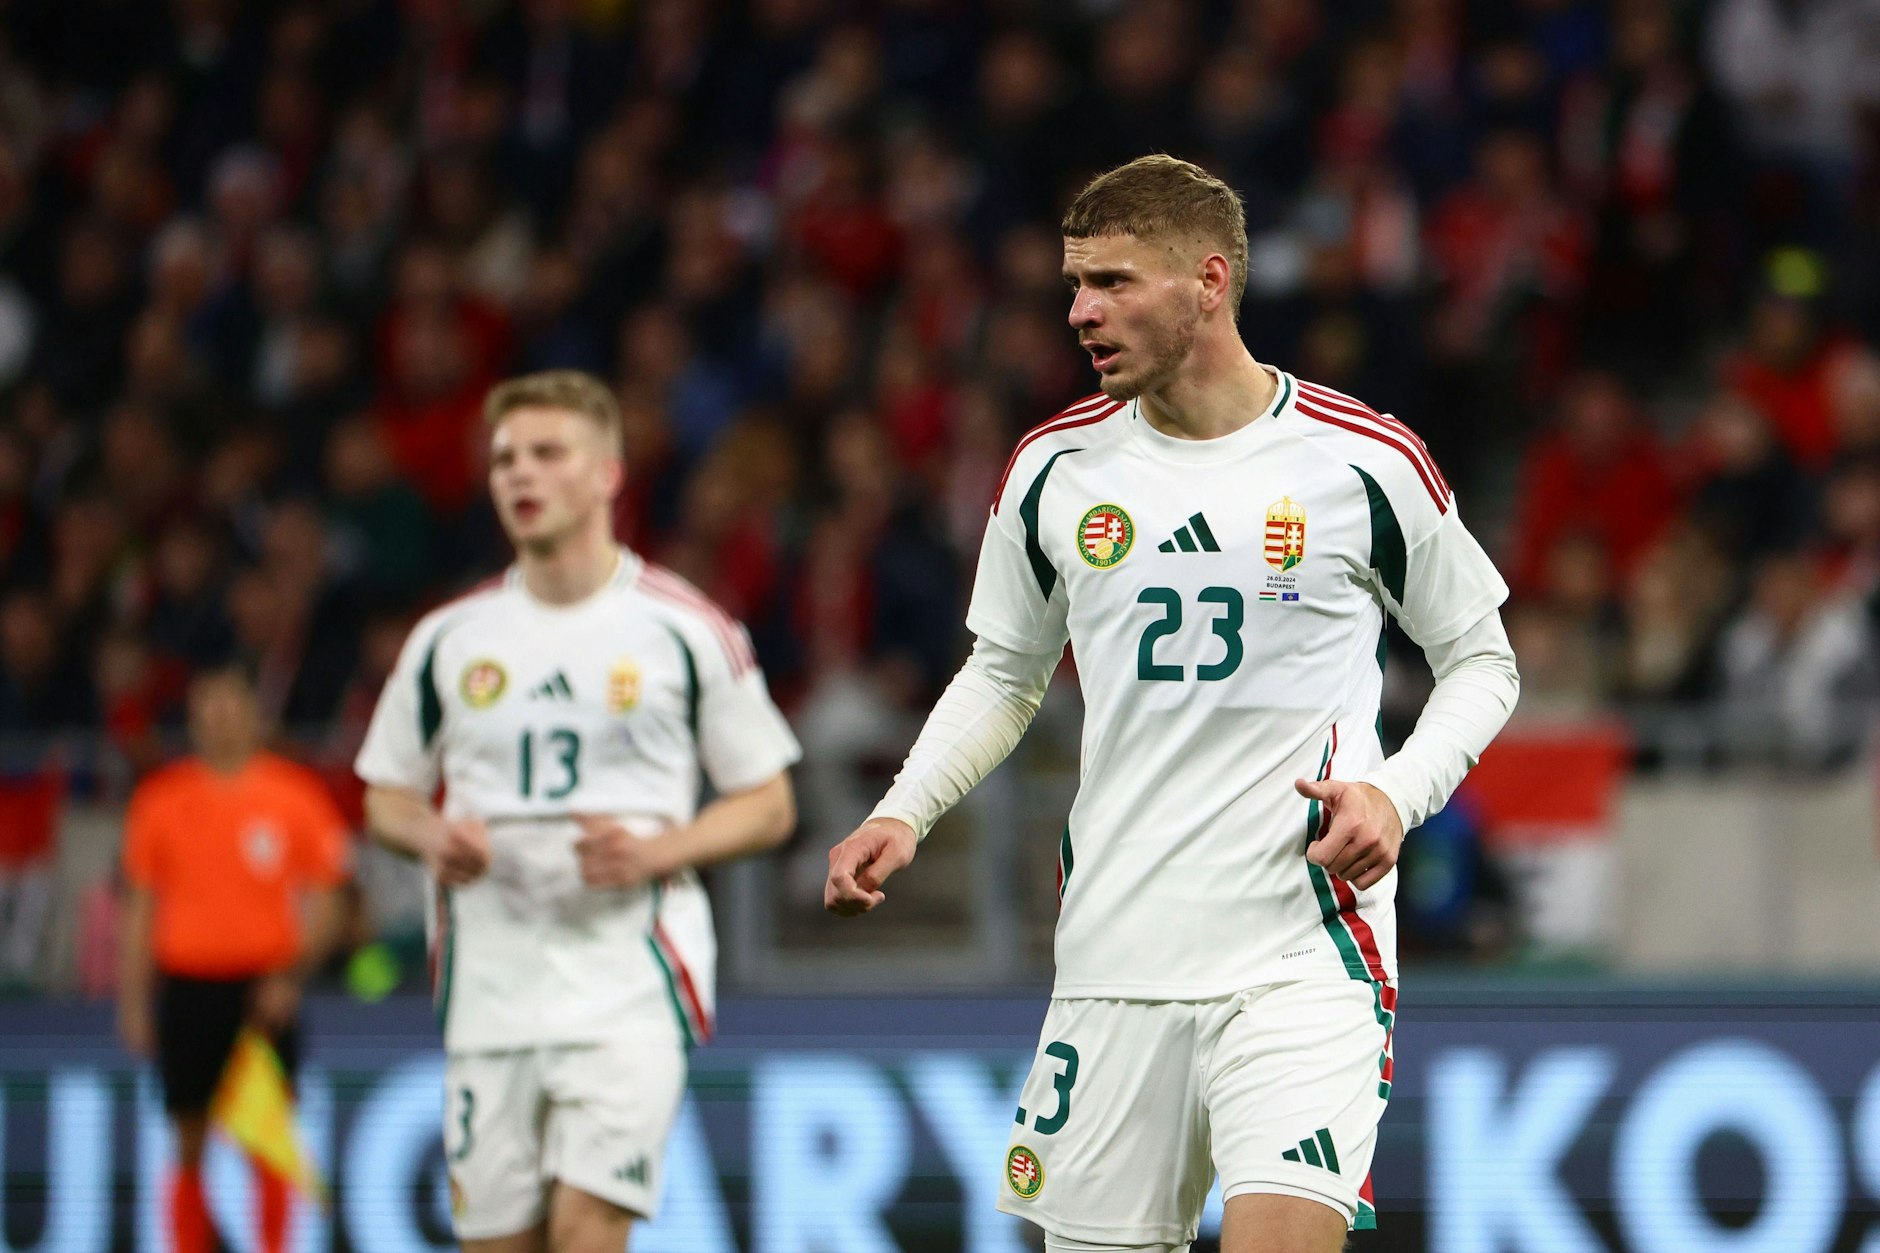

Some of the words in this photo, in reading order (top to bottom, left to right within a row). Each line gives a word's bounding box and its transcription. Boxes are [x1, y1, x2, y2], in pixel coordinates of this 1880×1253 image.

[1095, 559, 1112, 567] 1901
[1266, 582, 1295, 590] BUDAPEST
[1137, 586, 1244, 681] 23
[520, 727, 580, 799] 13
[1281, 947, 1316, 960] AEROREADY
[1015, 1041, 1079, 1135] 3
[1423, 1037, 1880, 1253] KO
